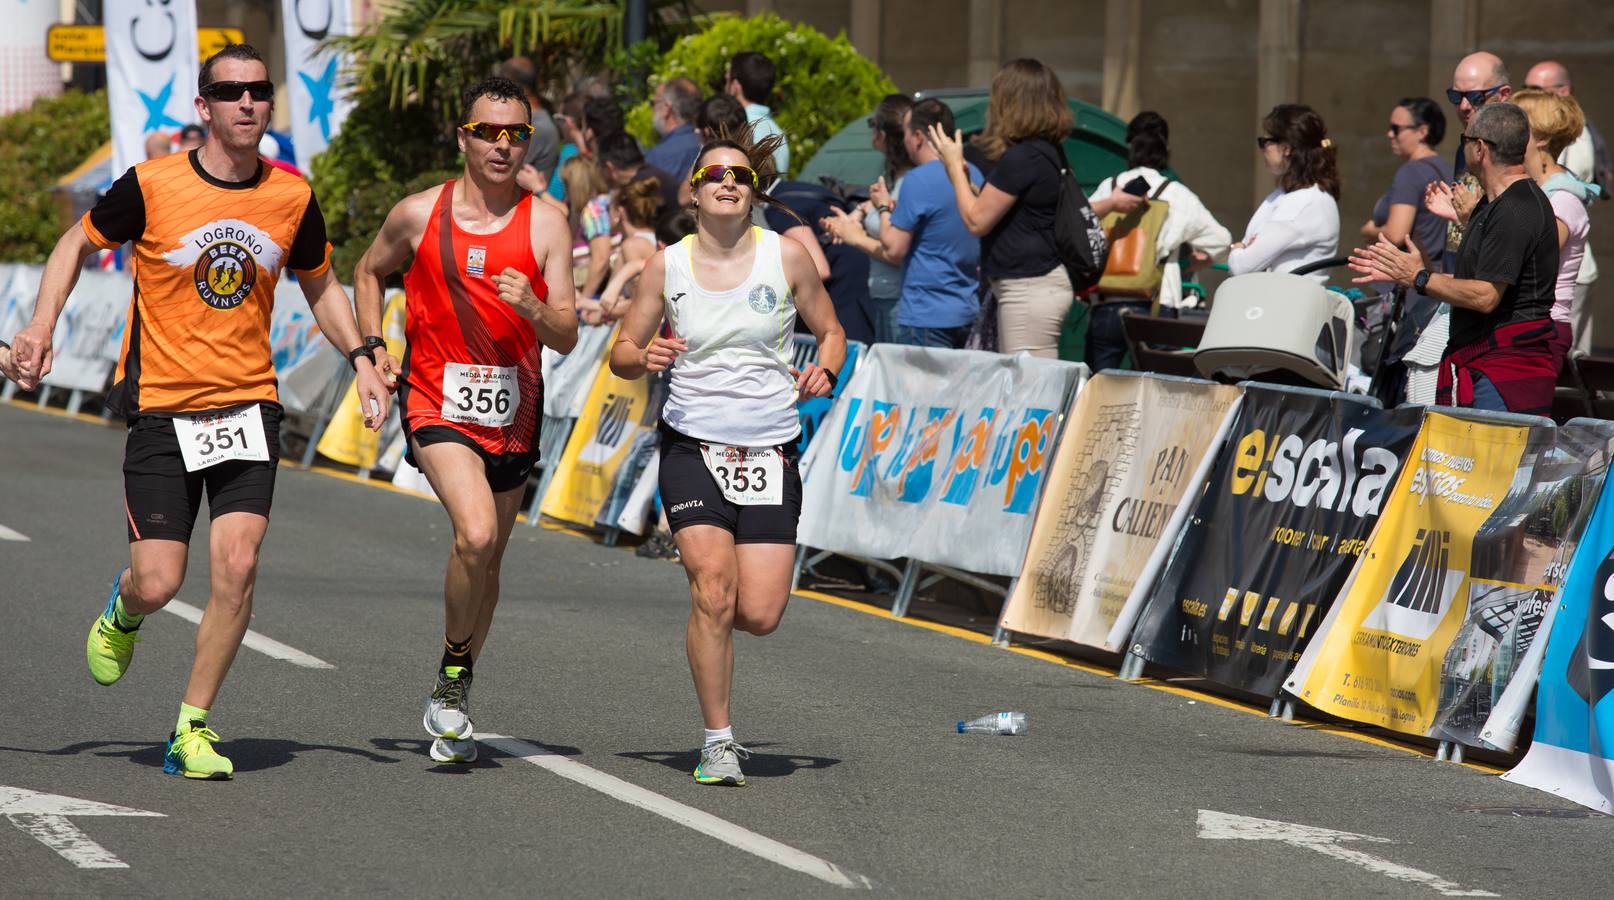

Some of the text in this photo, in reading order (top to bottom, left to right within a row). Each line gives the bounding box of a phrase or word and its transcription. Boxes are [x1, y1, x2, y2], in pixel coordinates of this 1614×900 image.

[195, 227, 263, 255] LOGROÑO
[208, 245, 247, 261] BEER
[197, 281, 251, 307] RUNNERS
[457, 386, 510, 414] 356
[194, 427, 248, 456] 351
[716, 466, 767, 492] 353
[1150, 446, 1189, 488] PAN
